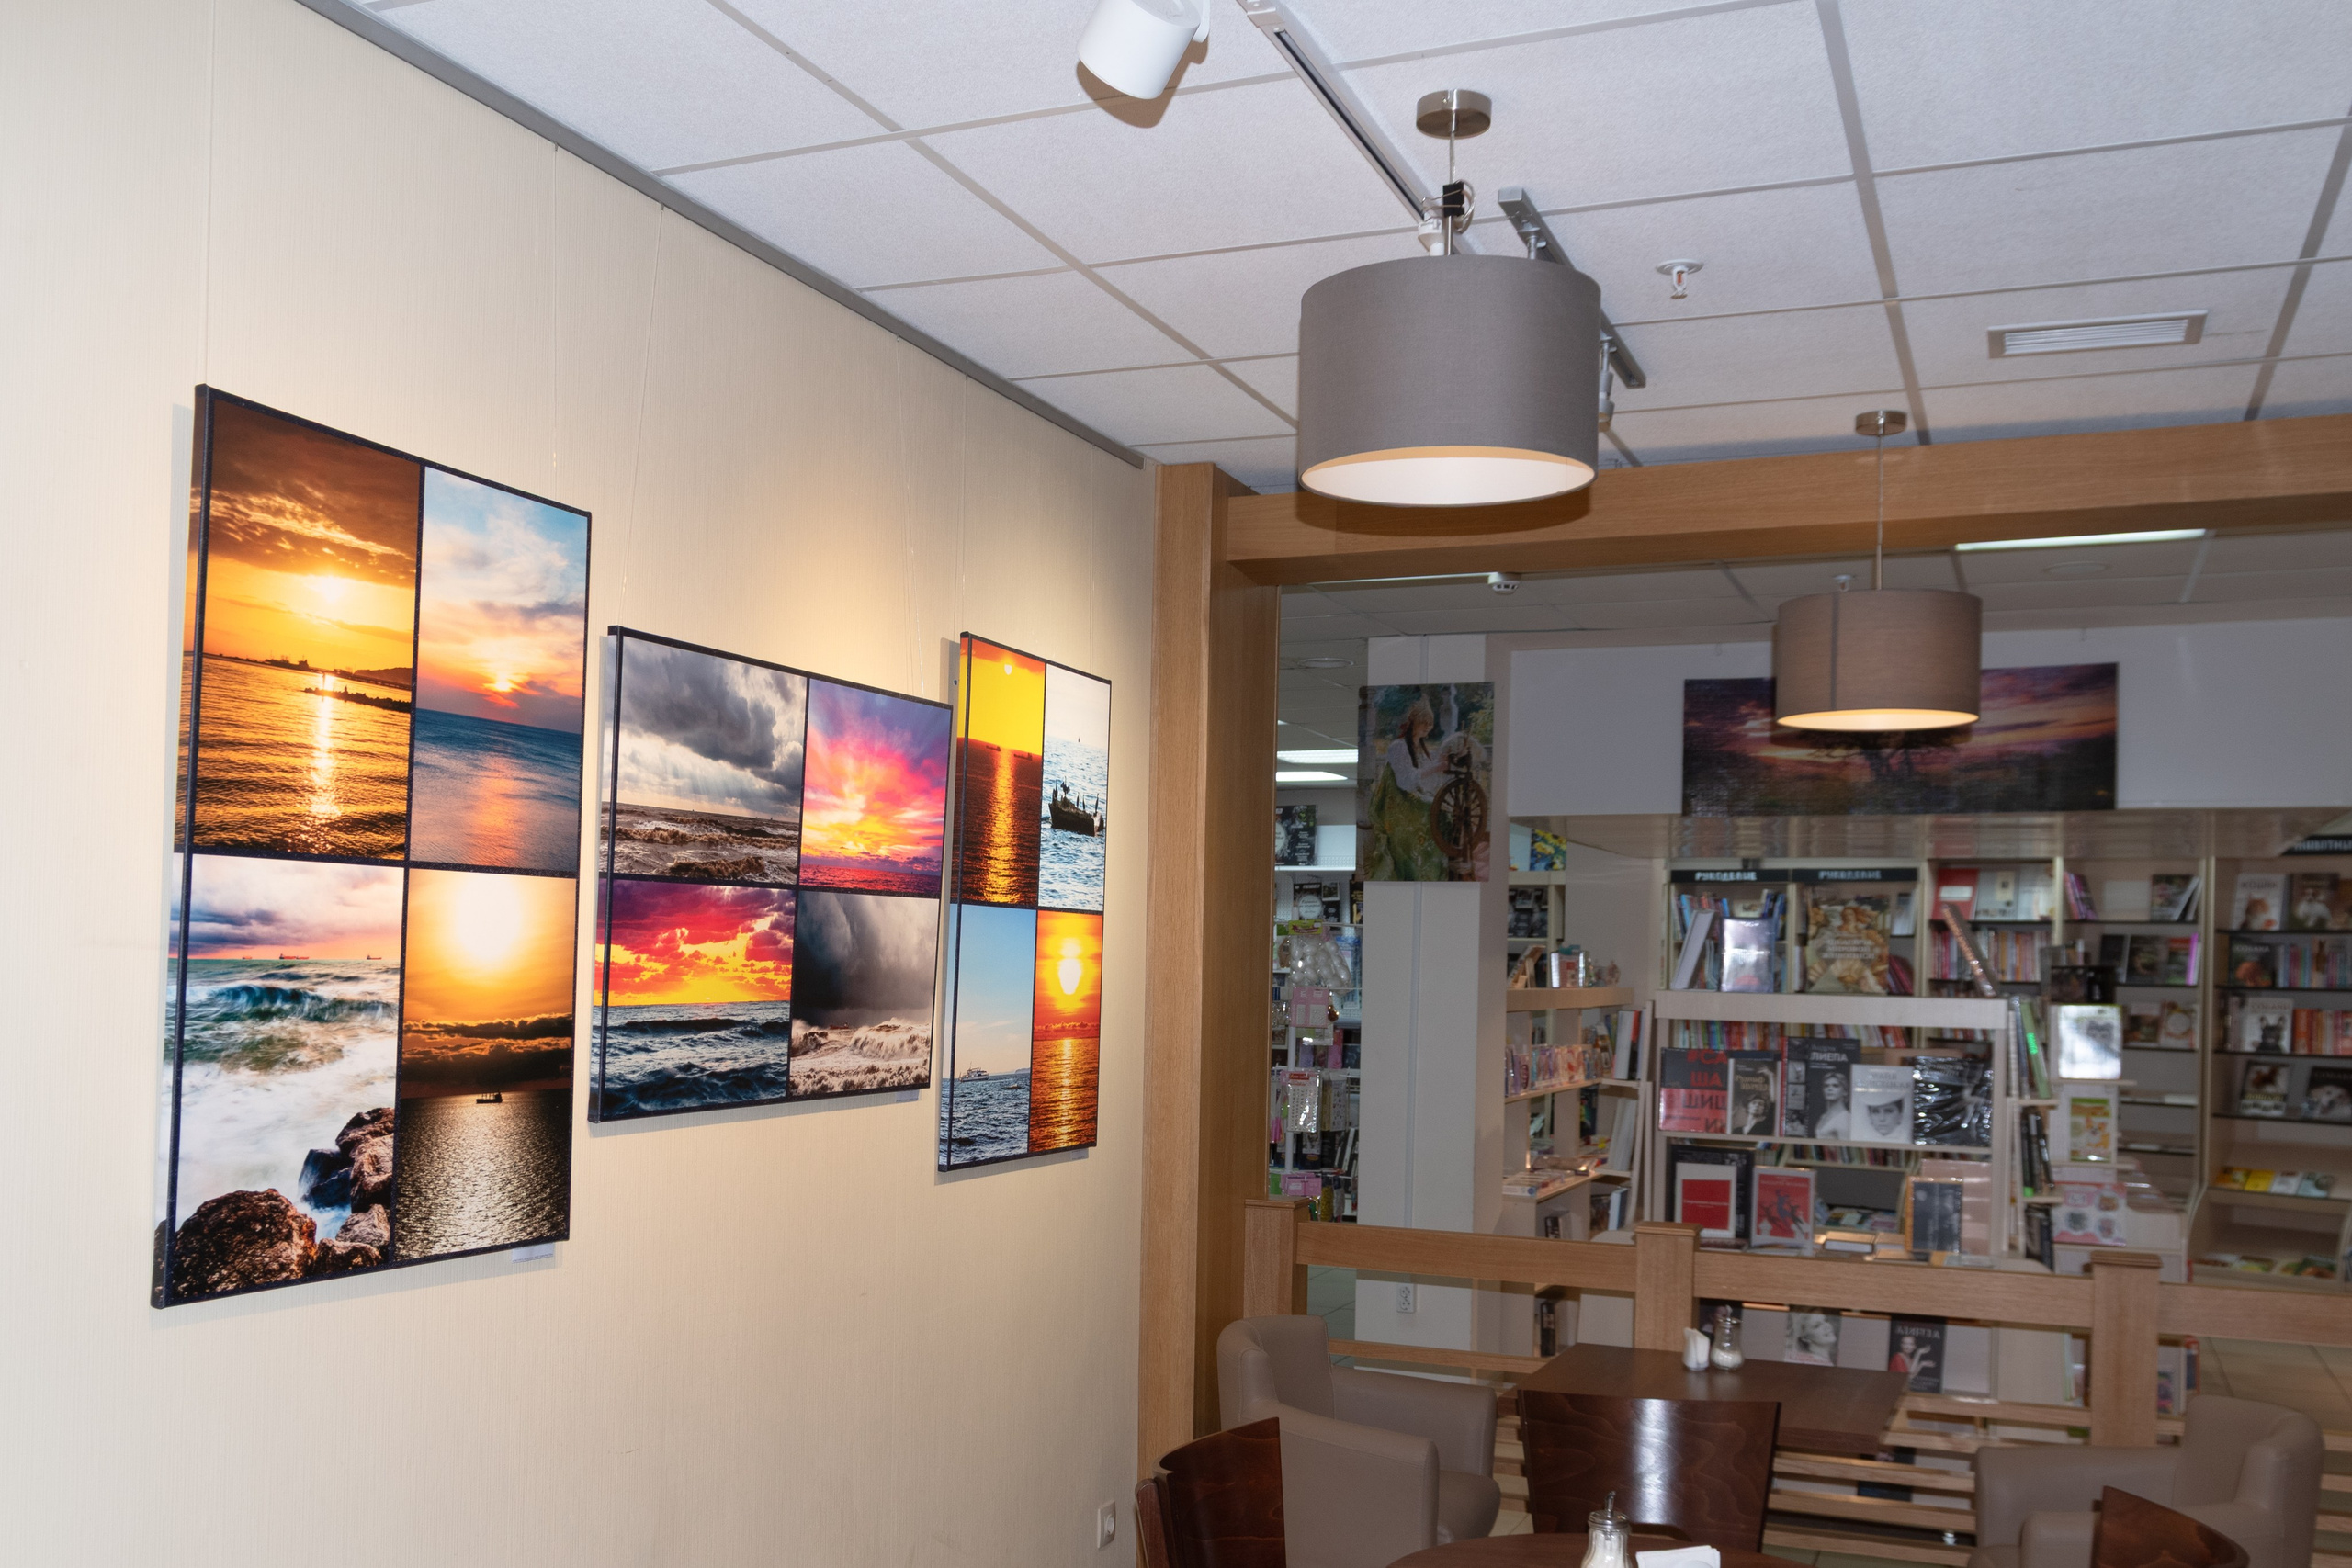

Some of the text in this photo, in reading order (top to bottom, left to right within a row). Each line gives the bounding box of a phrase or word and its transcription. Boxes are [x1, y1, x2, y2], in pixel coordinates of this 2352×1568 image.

[1695, 871, 1757, 881] РУКОДЕЛИЕ
[1810, 1052, 1849, 1062] ЛИЕПА
[1691, 1071, 1723, 1087] ША
